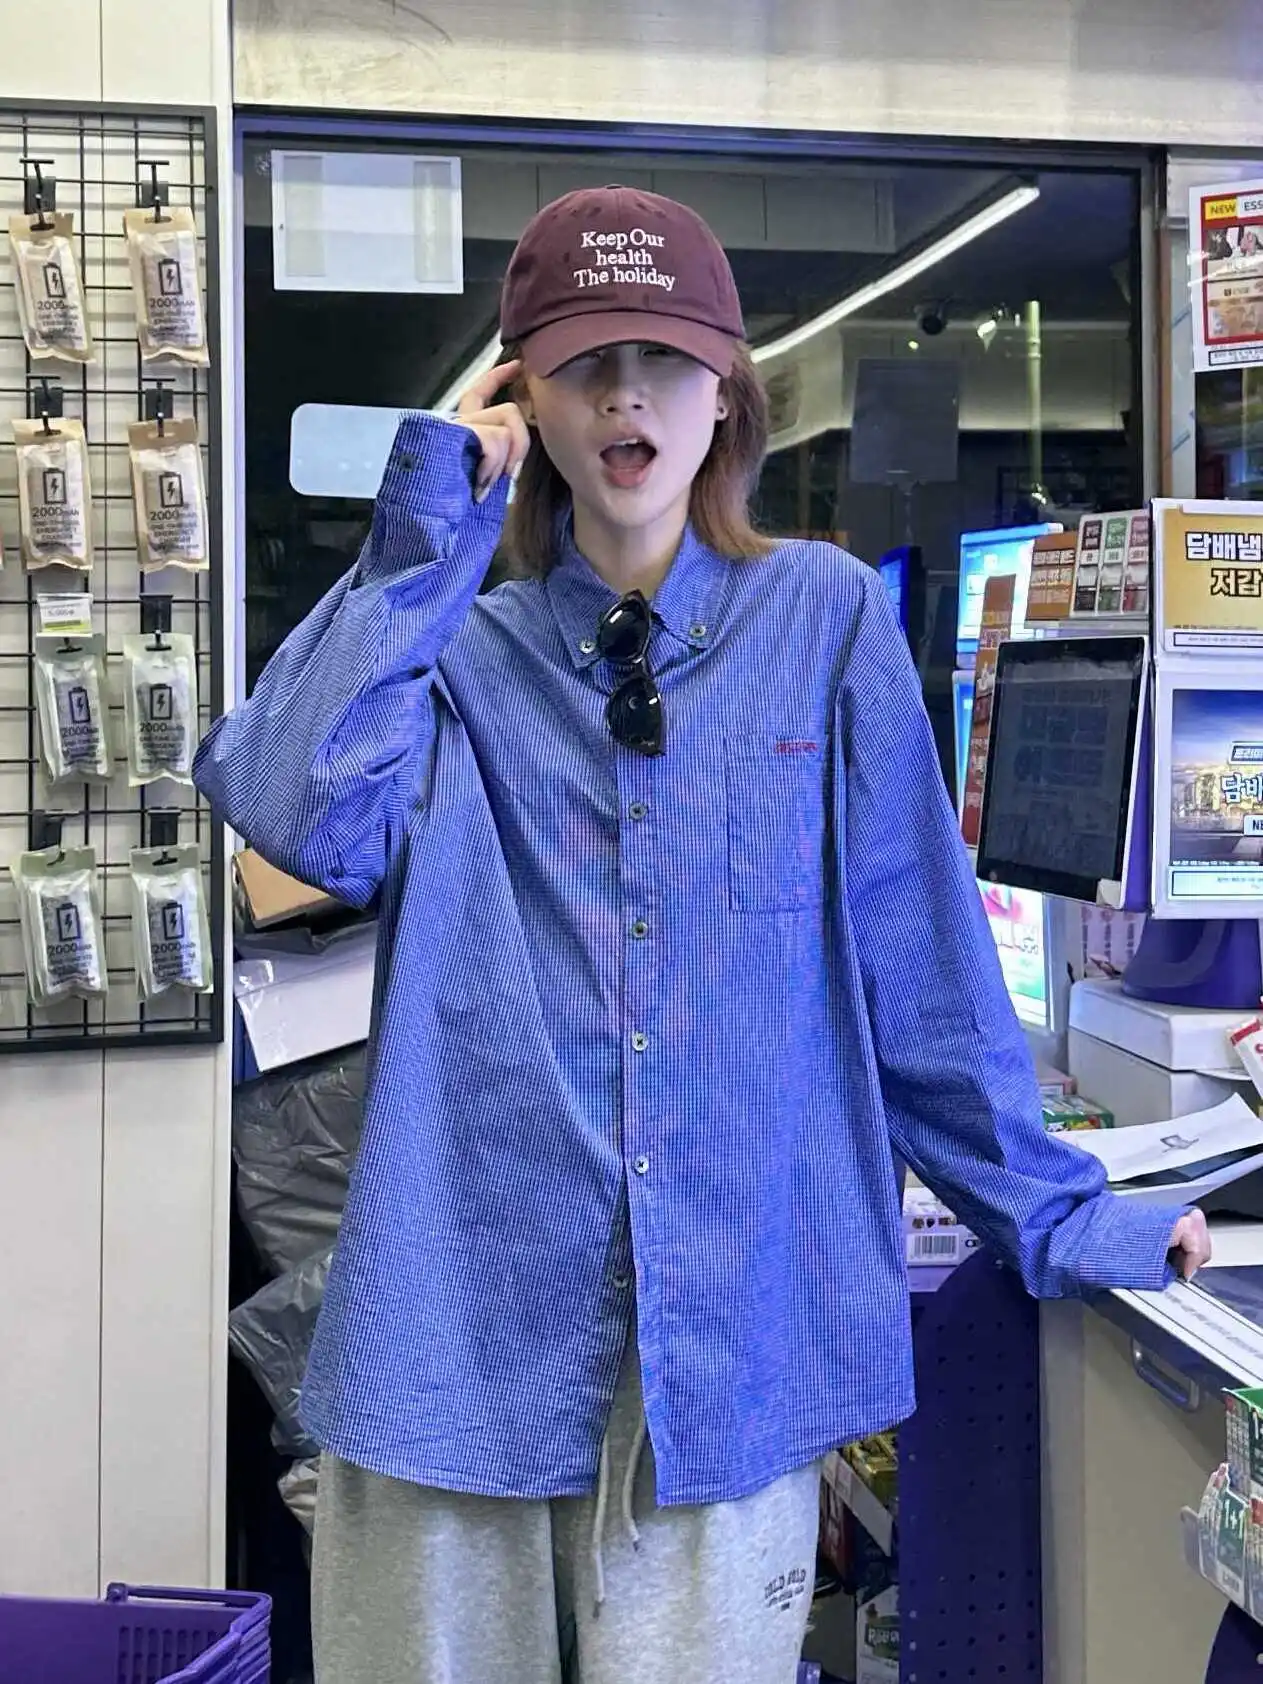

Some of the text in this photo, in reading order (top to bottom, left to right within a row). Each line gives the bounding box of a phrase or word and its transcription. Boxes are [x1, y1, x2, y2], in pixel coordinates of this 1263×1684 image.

[1210, 203, 1235, 214] NEW
[580, 228, 665, 250] Keep Our
[595, 248, 653, 266] health
[573, 266, 676, 291] The holiday
